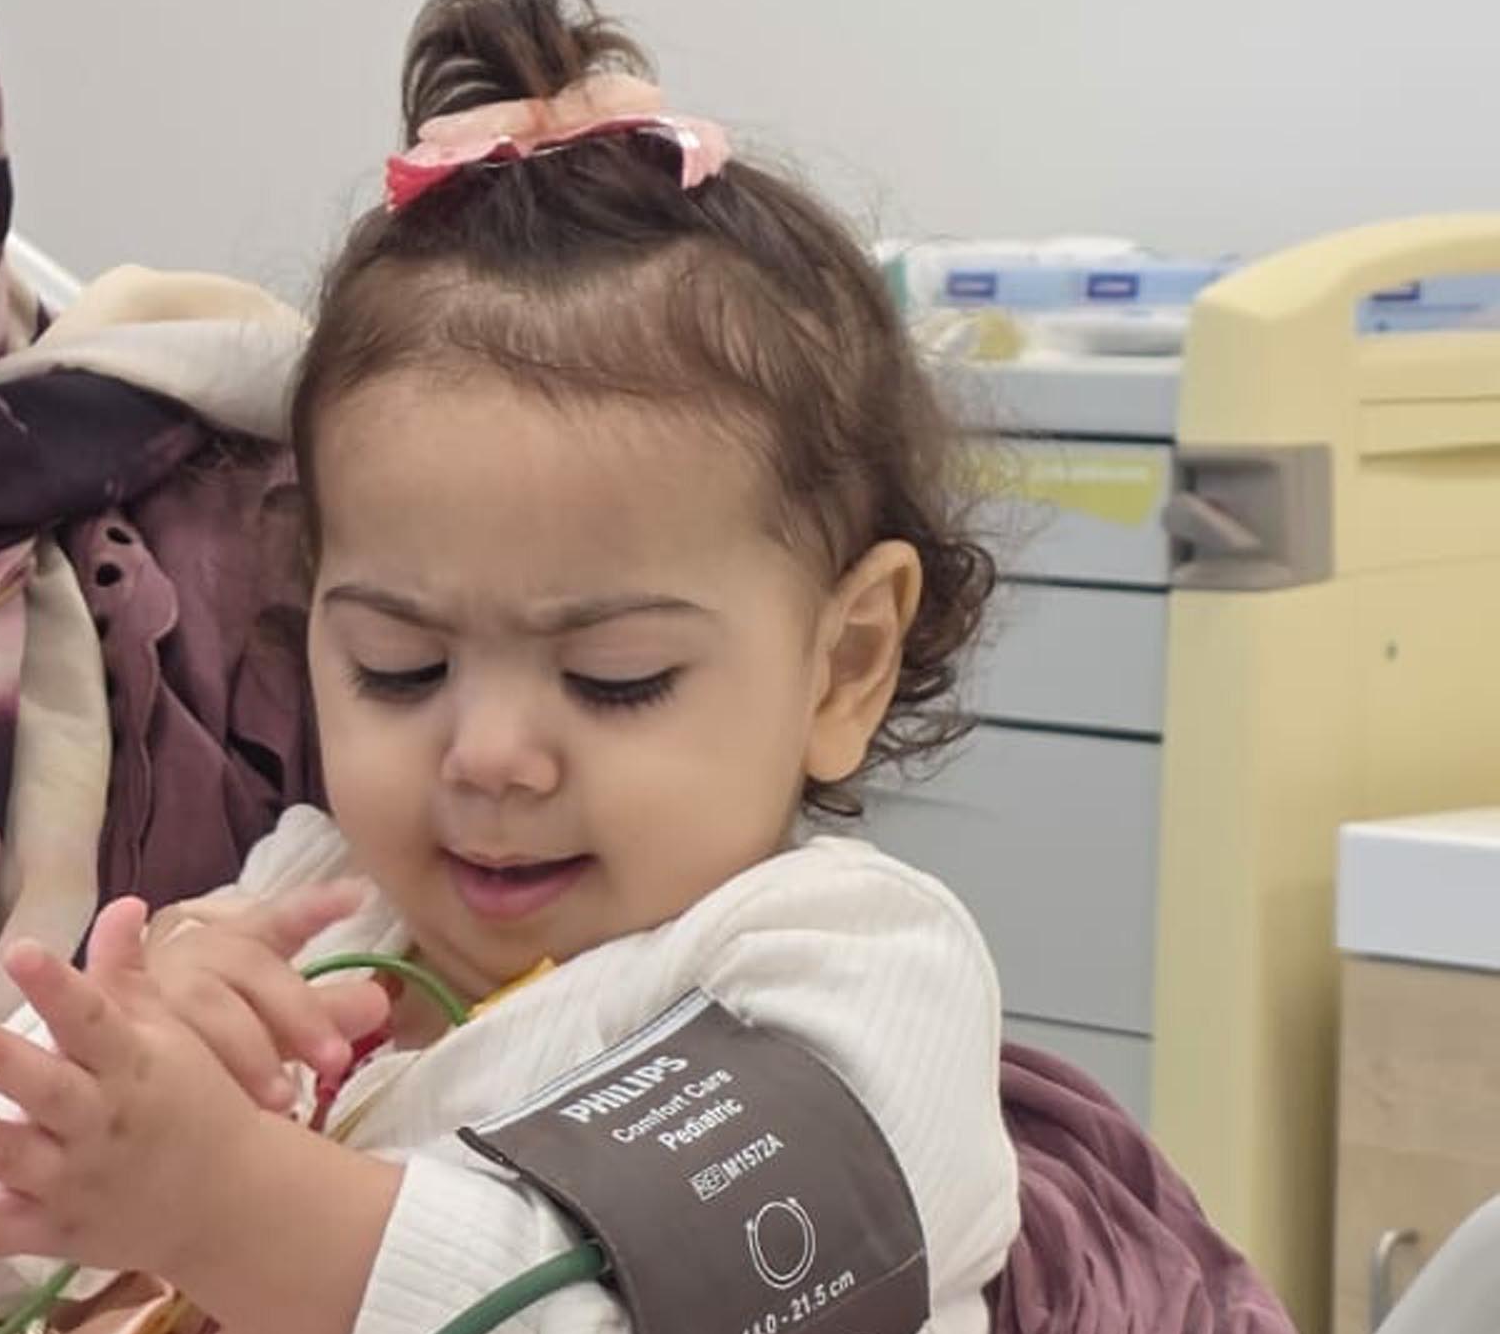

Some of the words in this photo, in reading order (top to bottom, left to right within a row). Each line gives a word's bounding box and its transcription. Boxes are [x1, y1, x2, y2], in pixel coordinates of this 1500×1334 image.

[559, 1056, 688, 1123] PHILIPS
[612, 1094, 691, 1143] Comfort
[683, 1069, 733, 1098] Care
[658, 1098, 744, 1151] Pediatric
[694, 1166, 727, 1198] REF
[722, 1133, 784, 1180] M1572A
[791, 1283, 826, 1321] 21.5
[829, 1270, 855, 1298] cm
